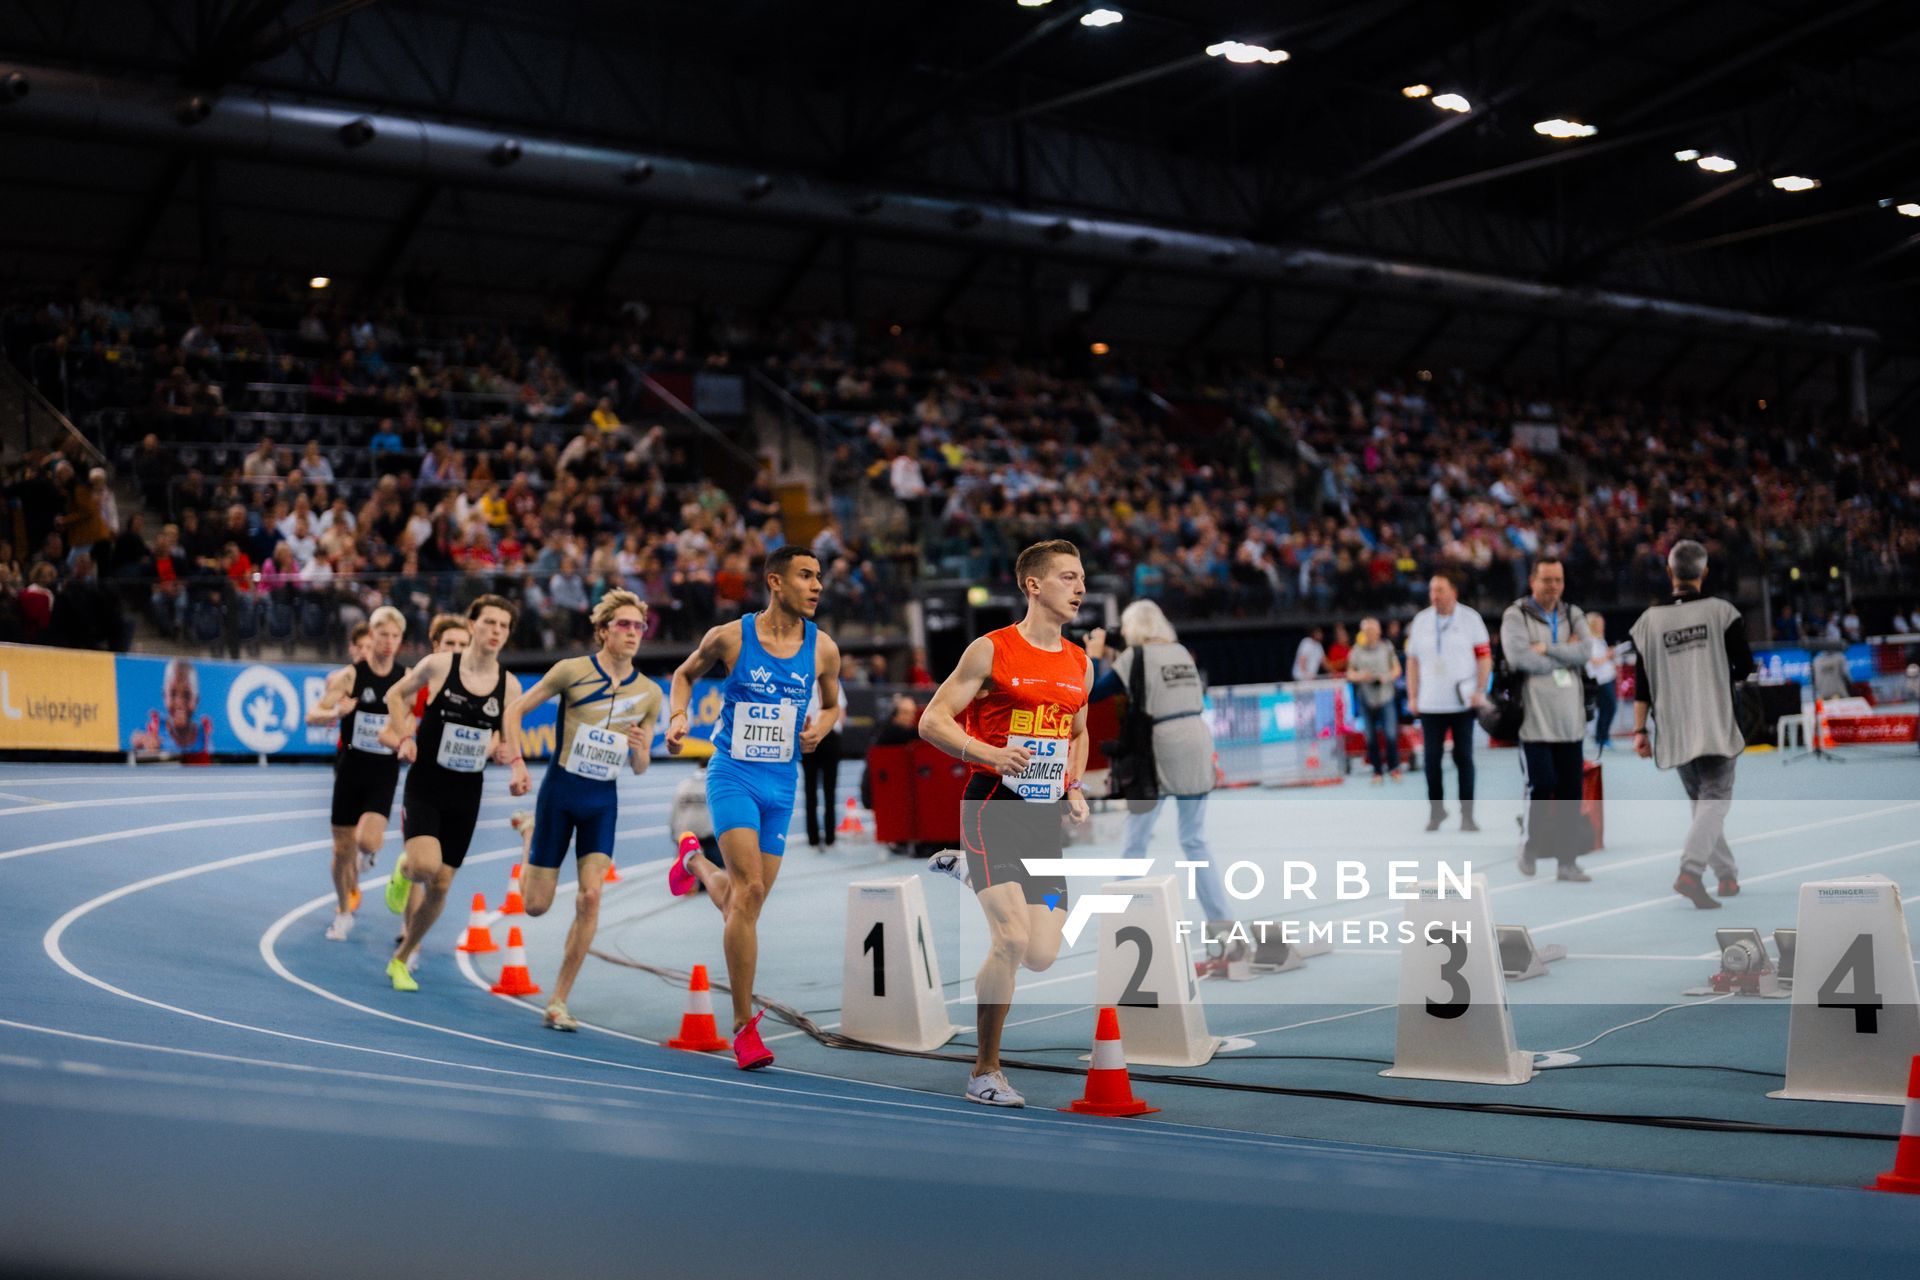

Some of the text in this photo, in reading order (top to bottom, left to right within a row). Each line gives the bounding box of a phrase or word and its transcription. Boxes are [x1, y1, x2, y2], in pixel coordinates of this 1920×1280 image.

[26, 693, 99, 726] Leipziger
[748, 705, 780, 720] GLS
[454, 727, 481, 741] GLS
[588, 729, 616, 745] GLS
[743, 724, 786, 742] ZITTEL
[574, 742, 623, 766] M.TORTELL
[760, 746, 780, 755] PLAN
[1023, 740, 1057, 757] GLS
[1008, 762, 1064, 781] .BEIMLER
[1030, 786, 1050, 794] PLAN
[1818, 888, 1864, 896] THÜRINGER
[863, 921, 886, 997] 1
[1114, 925, 1159, 1008] 2
[1425, 928, 1472, 1020] 3
[1817, 933, 1884, 1034] 4
